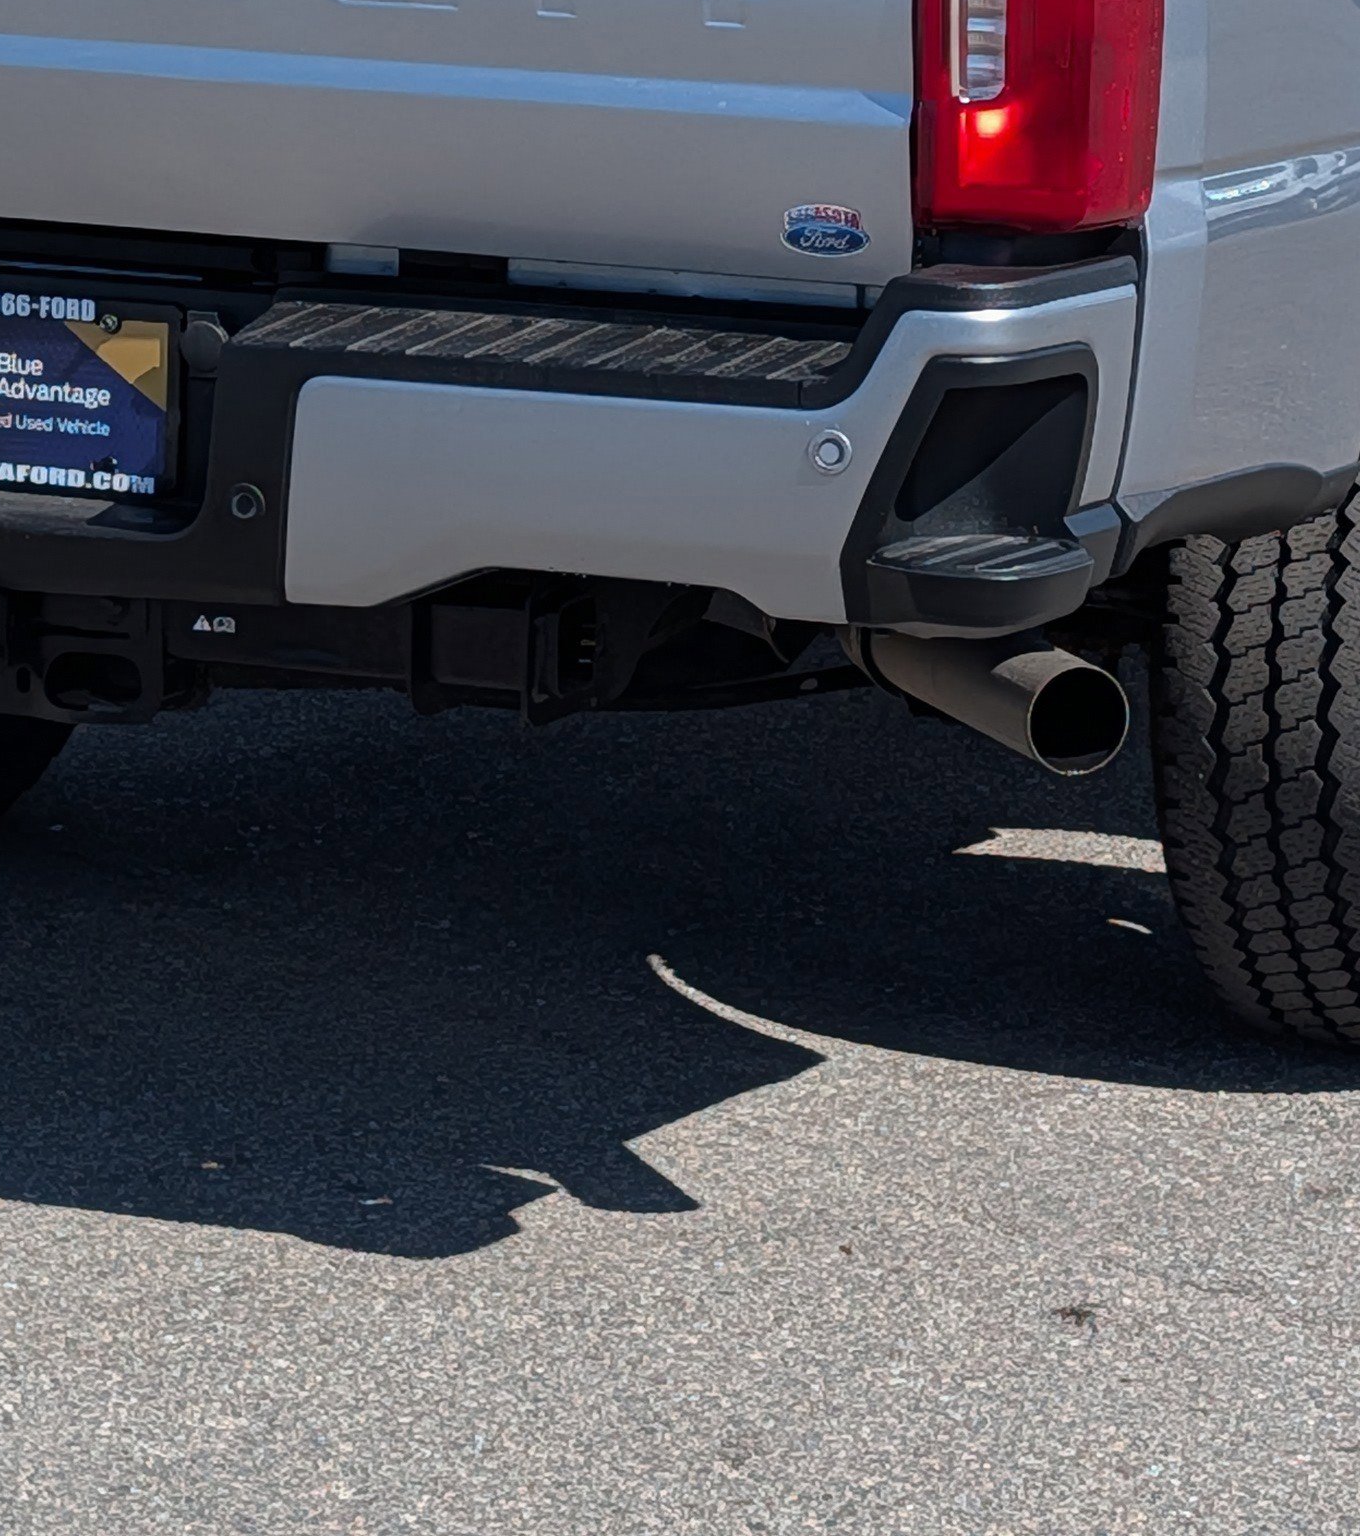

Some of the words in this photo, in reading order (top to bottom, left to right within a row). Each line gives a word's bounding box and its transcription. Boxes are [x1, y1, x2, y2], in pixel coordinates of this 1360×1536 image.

[799, 224, 851, 250] Ford
[15, 414, 54, 433] Used
[56, 417, 111, 437] Vehicle
